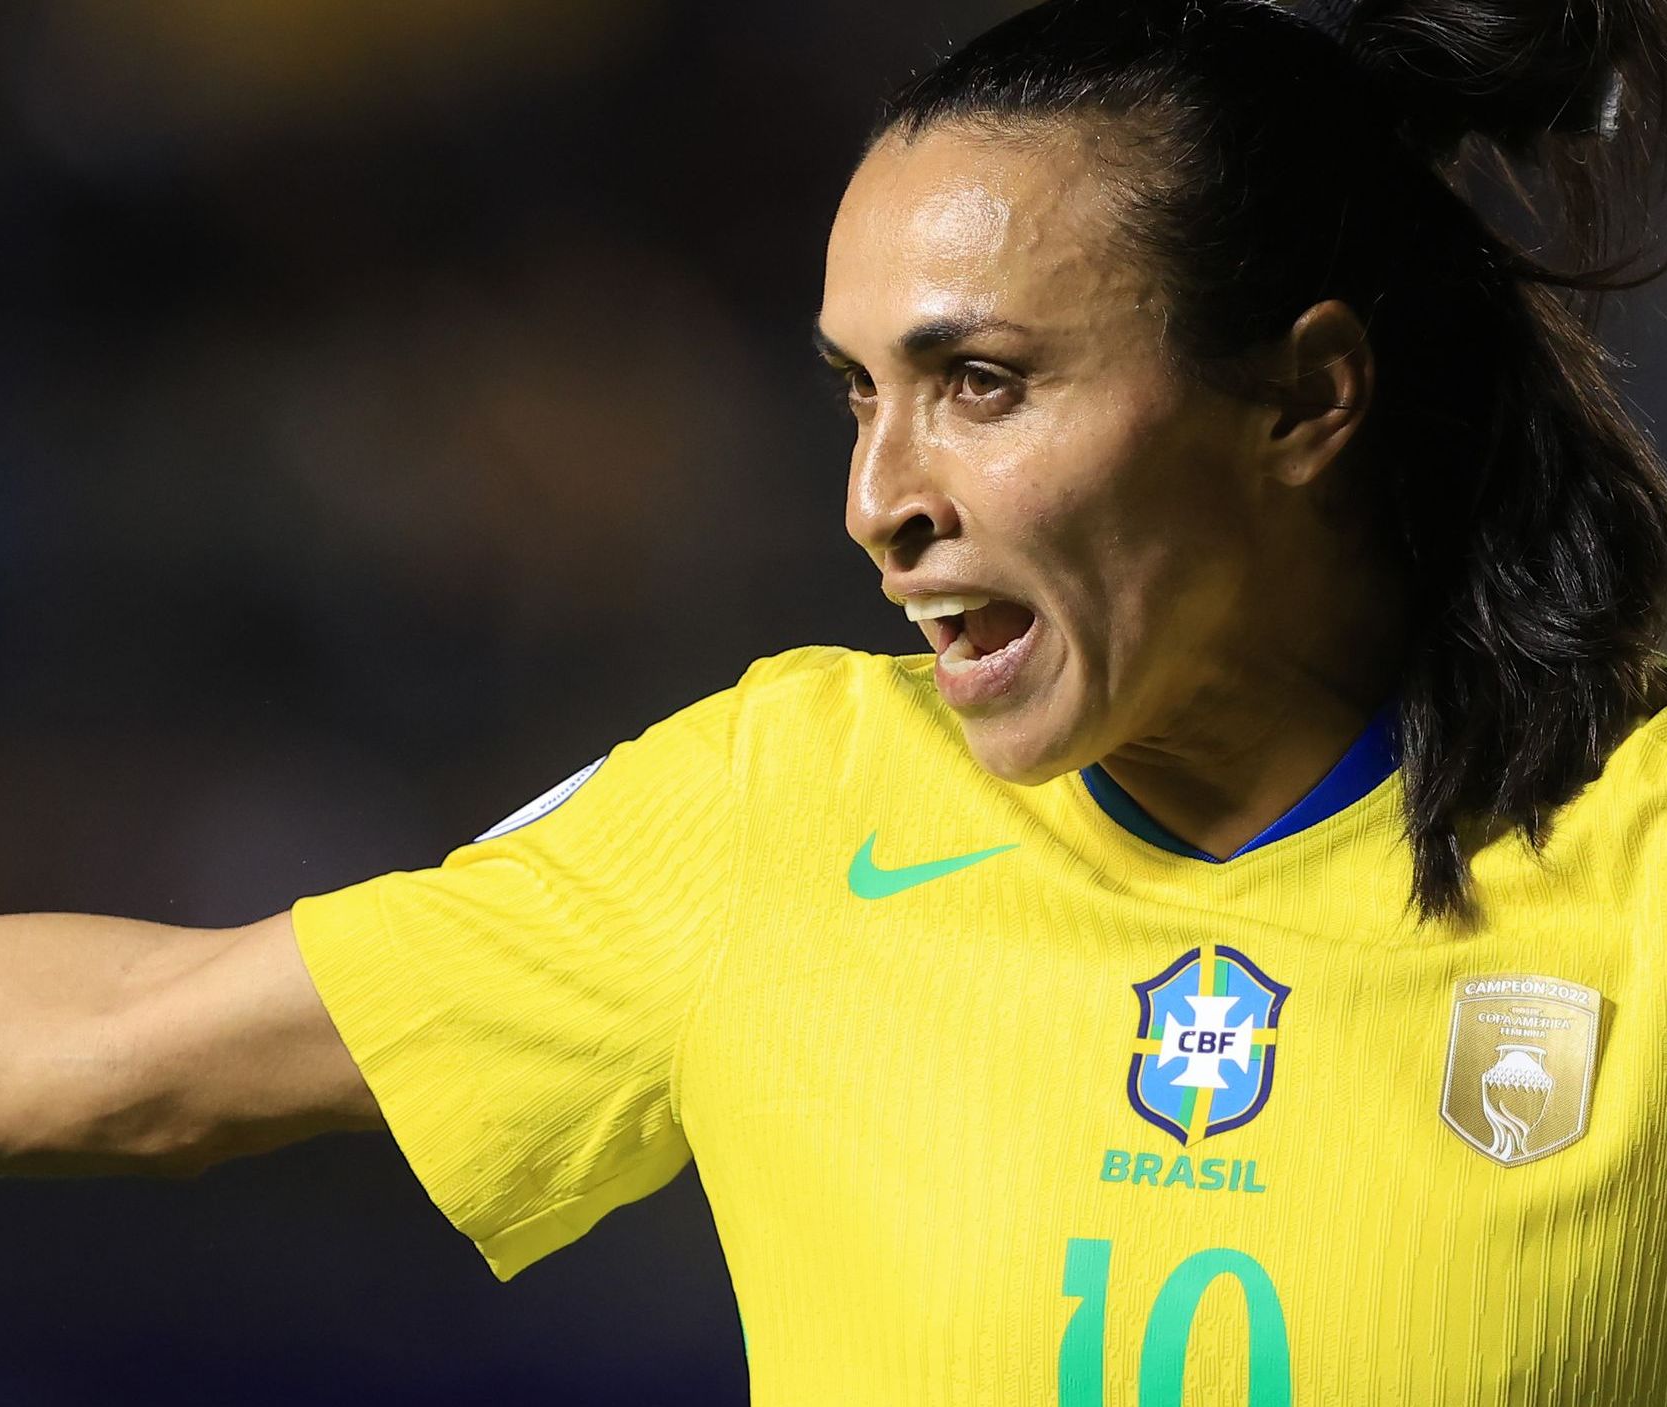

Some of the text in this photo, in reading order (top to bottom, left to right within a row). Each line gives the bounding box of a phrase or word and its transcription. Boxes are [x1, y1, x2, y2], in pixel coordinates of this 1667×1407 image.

[1547, 984, 1589, 1004] 2022
[1477, 1011, 1512, 1025] COPA
[1178, 1030, 1236, 1054] CBF
[1100, 1149, 1266, 1193] BRASIL
